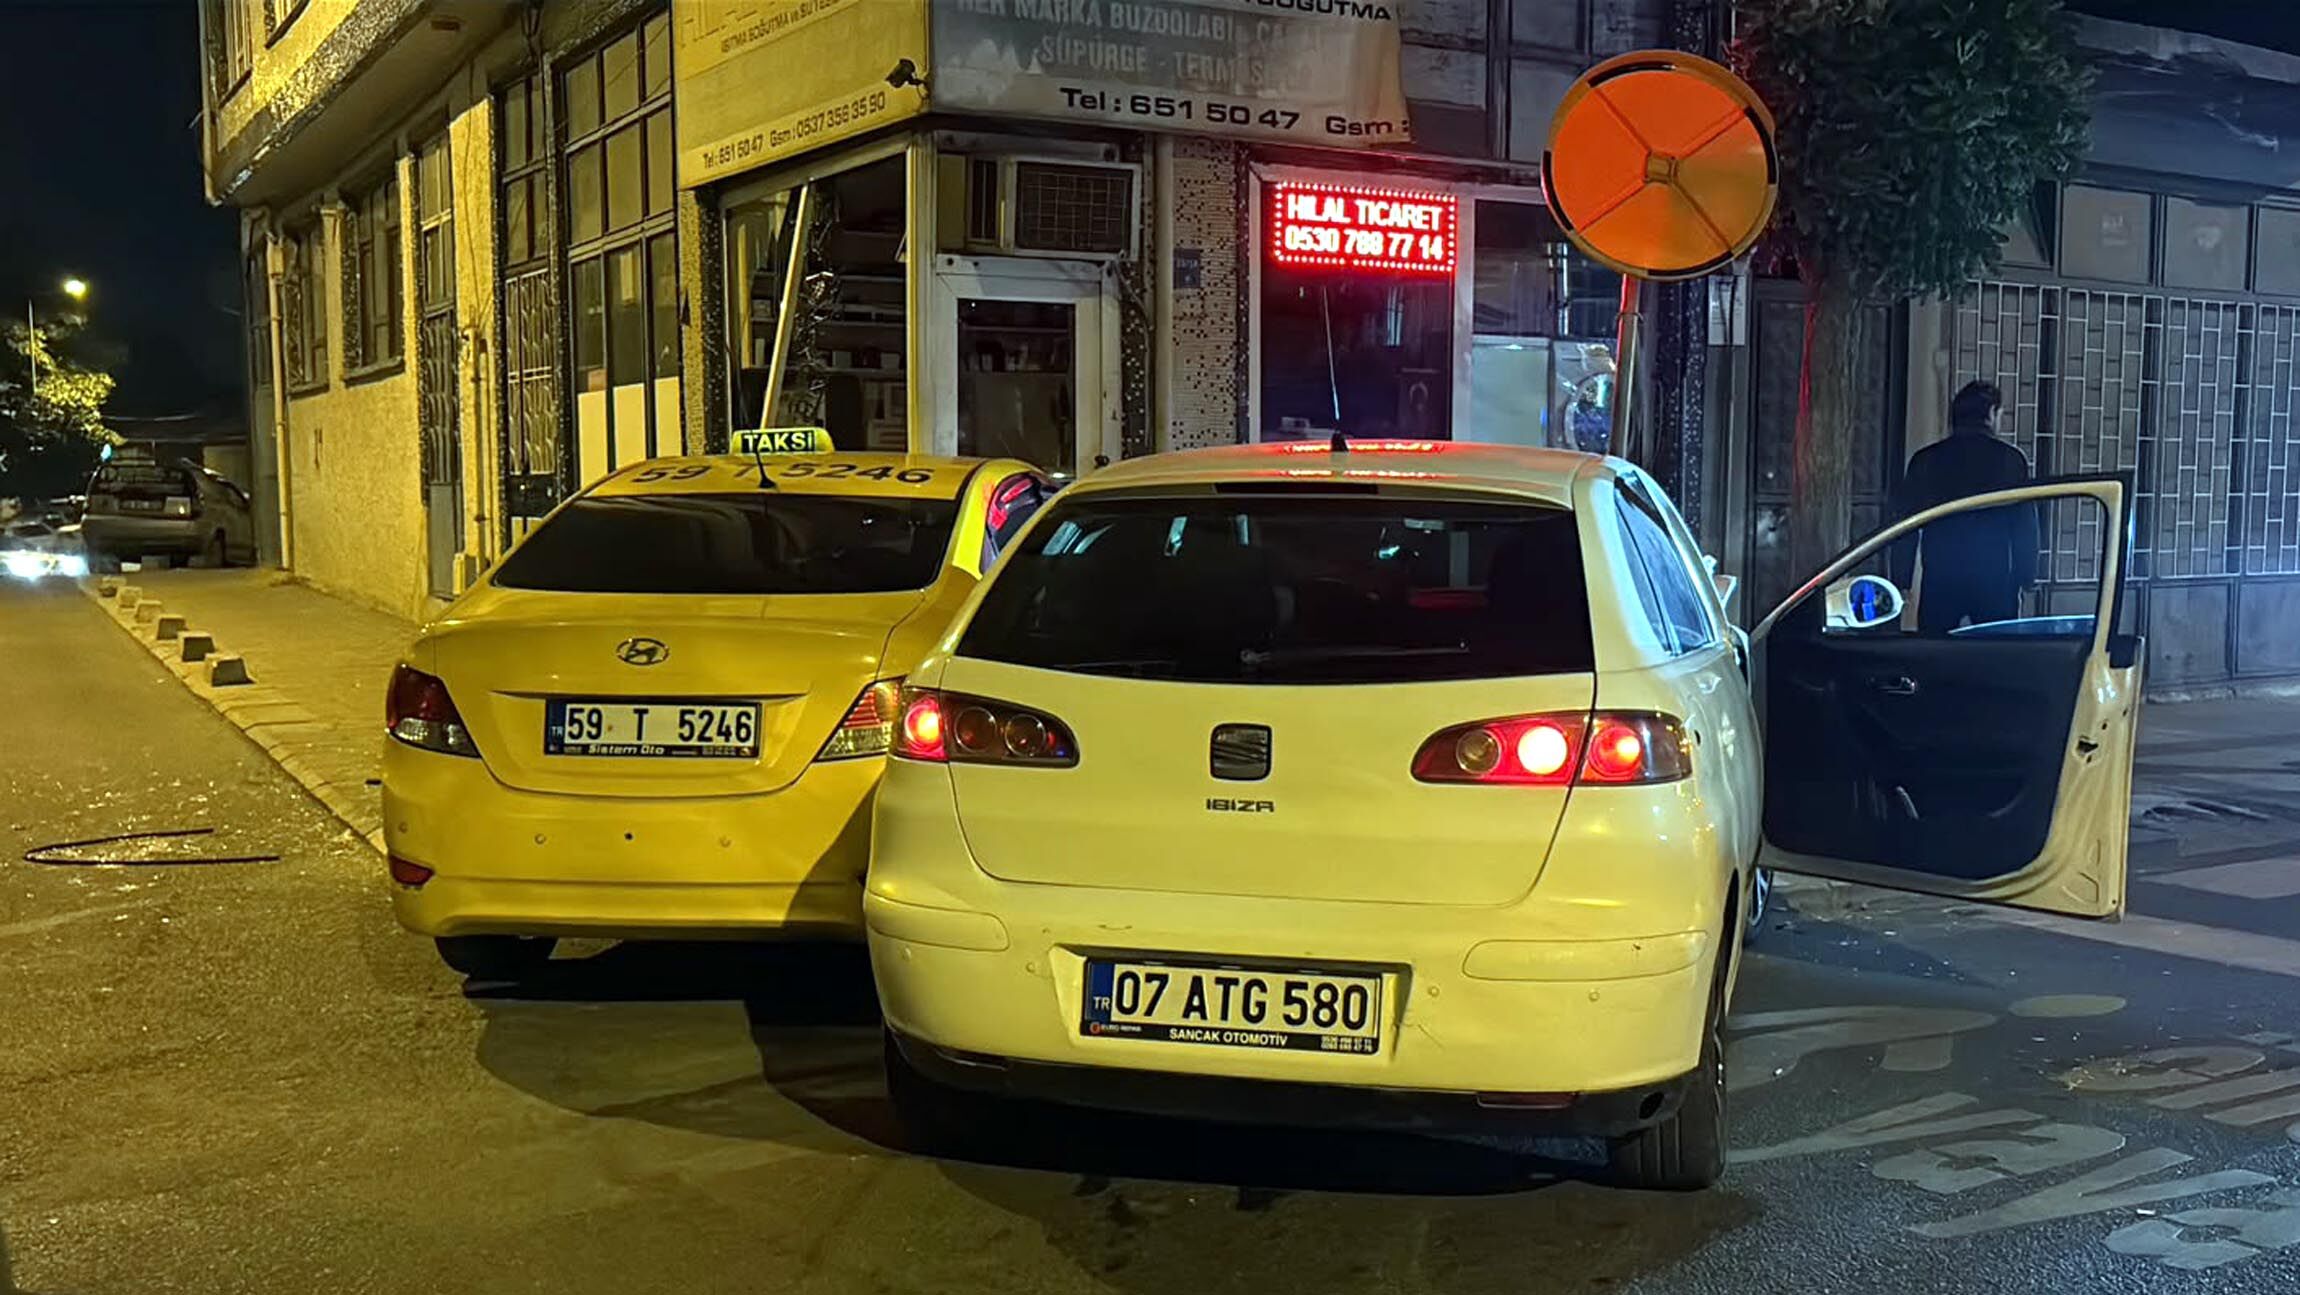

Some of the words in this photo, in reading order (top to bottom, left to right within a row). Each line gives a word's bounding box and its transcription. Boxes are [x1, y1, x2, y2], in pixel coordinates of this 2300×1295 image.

[1040, 32, 1147, 73] SÜPÜRGE
[1130, 95, 1193, 119] 651
[1206, 104, 1251, 125] 50
[1258, 109, 1300, 130] 47
[1325, 115, 1393, 136] Gsm
[703, 152, 714, 169] Tel
[751, 134, 764, 153] 47
[797, 113, 825, 138] 0537
[852, 97, 868, 120] 35
[1285, 225, 1341, 252] 0530
[1387, 231, 1414, 258] 77
[1418, 234, 1444, 261] 14
[632, 465, 713, 484] 59
[733, 462, 770, 478] T
[779, 463, 935, 484] 5246
[551, 726, 563, 737] TR
[567, 707, 604, 740] 59
[633, 708, 649, 741] T
[678, 708, 753, 743] 5246
[588, 744, 637, 755] Sistem
[1206, 798, 1275, 813] IBIZA
[1093, 996, 1111, 1011] TR
[1115, 969, 1169, 1017] 07
[1182, 975, 1269, 1024] ATG
[1282, 980, 1369, 1030] 580
[1169, 1027, 1219, 1043] SANCAK
